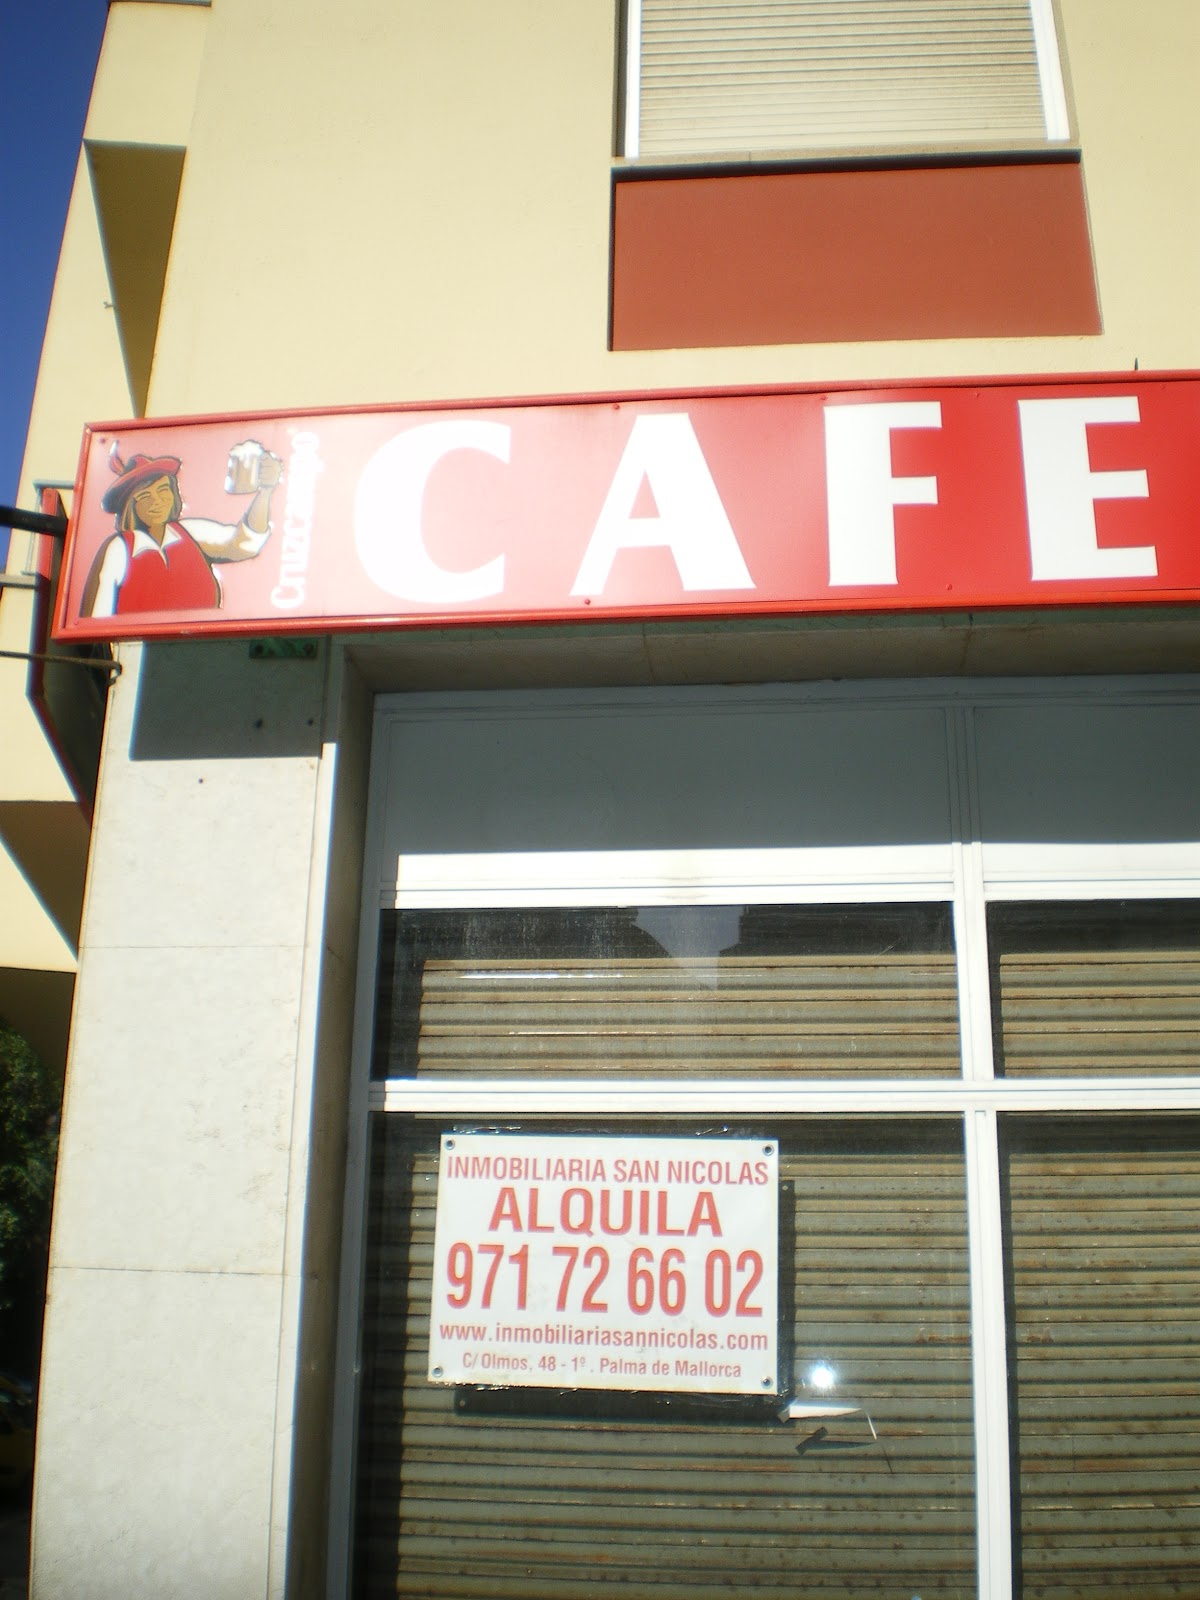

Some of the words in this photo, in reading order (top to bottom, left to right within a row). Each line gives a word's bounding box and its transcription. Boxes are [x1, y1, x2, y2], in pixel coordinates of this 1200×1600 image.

[353, 395, 1159, 603] CAFE
[447, 1156, 606, 1183] INMOBILIARIA
[613, 1159, 660, 1183] SAN
[667, 1161, 769, 1186] NICOLAS
[488, 1187, 723, 1237] ALQUILA
[446, 1242, 529, 1311] 971
[551, 1246, 609, 1313] 72
[627, 1247, 686, 1316] 66
[704, 1250, 764, 1318] 02
[439, 1322, 768, 1351] www.inmobiliariasannicolas.com
[538, 1356, 556, 1372] 48
[600, 1358, 647, 1375] Palma
[652, 1360, 670, 1375] de
[674, 1360, 742, 1378] Mallorca
